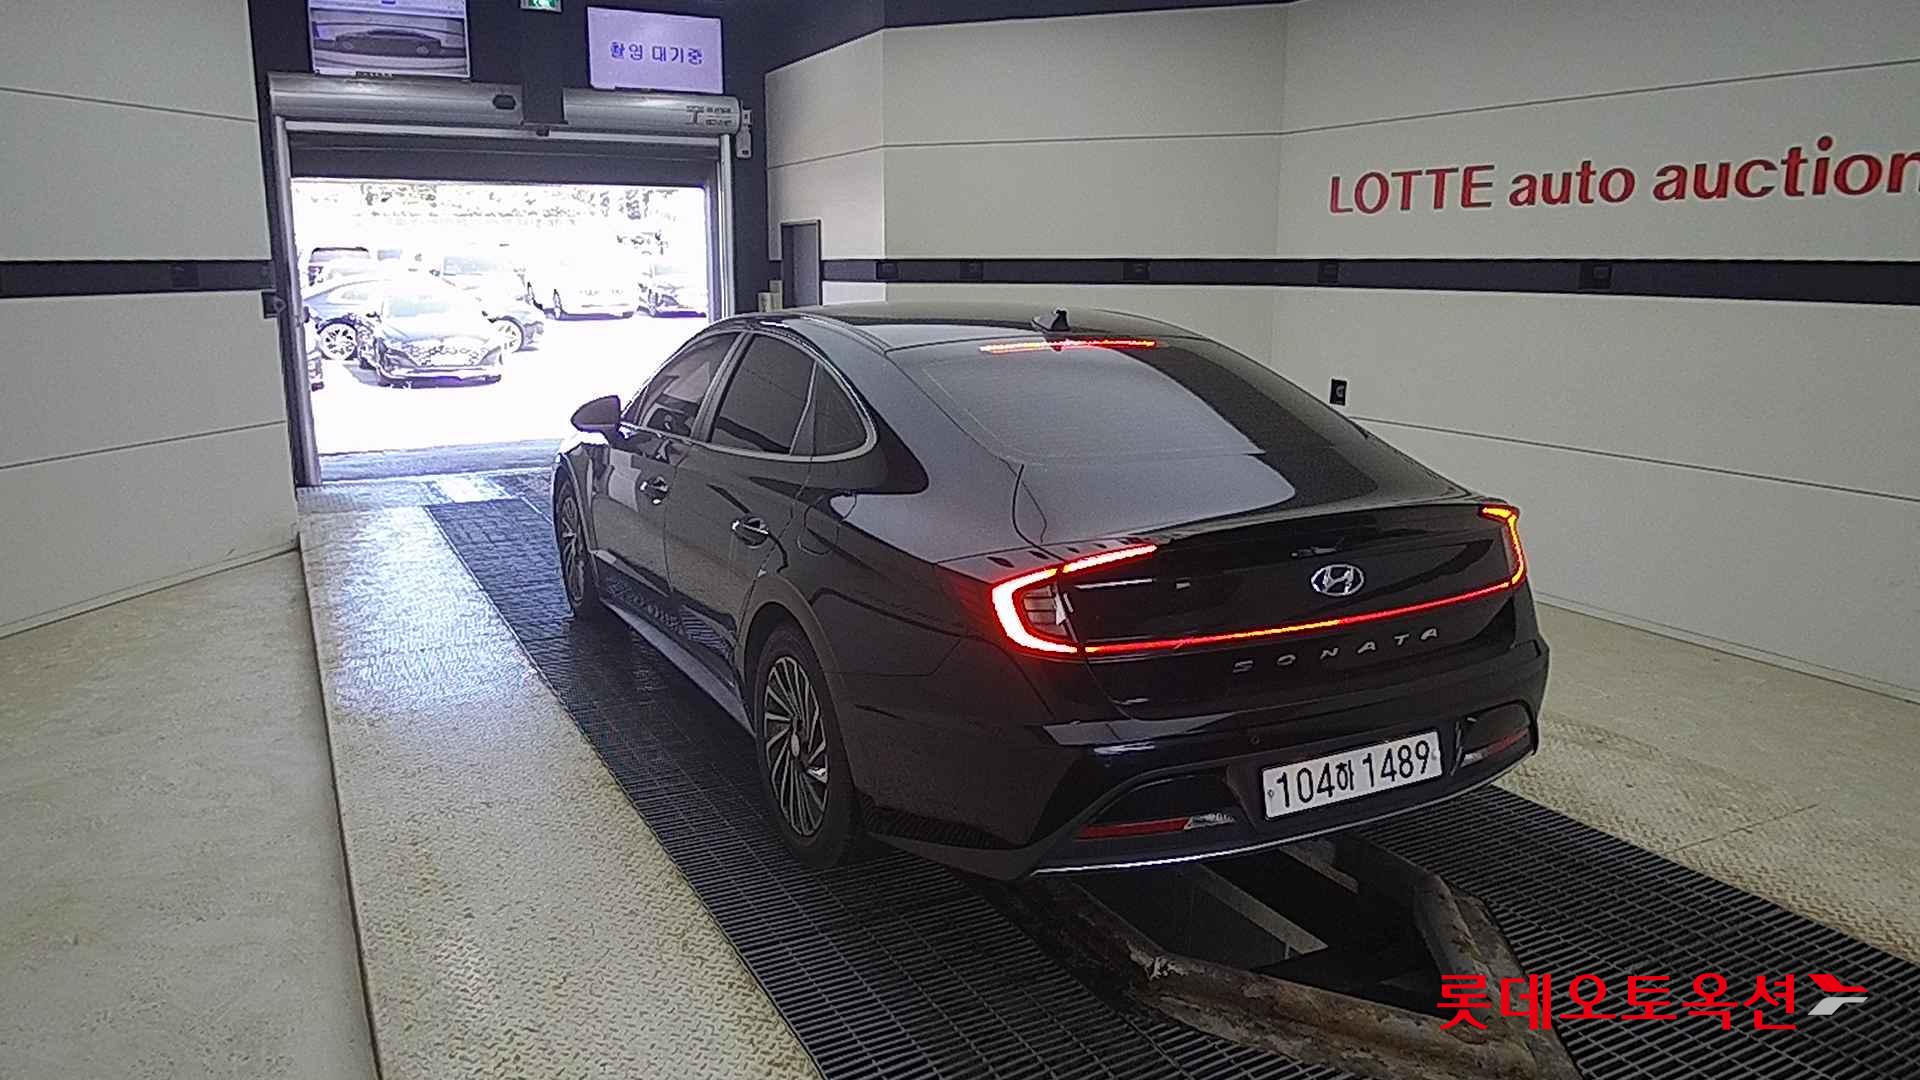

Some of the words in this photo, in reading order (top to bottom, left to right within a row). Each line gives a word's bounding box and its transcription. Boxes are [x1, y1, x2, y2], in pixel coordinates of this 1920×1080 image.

[652, 45, 703, 65] 대기중
[1329, 164, 1496, 214] LOTTE
[1508, 160, 1636, 207] auto
[1232, 627, 1438, 673] SONATA
[1276, 759, 1354, 808] 104하
[1362, 740, 1430, 788] 1489
